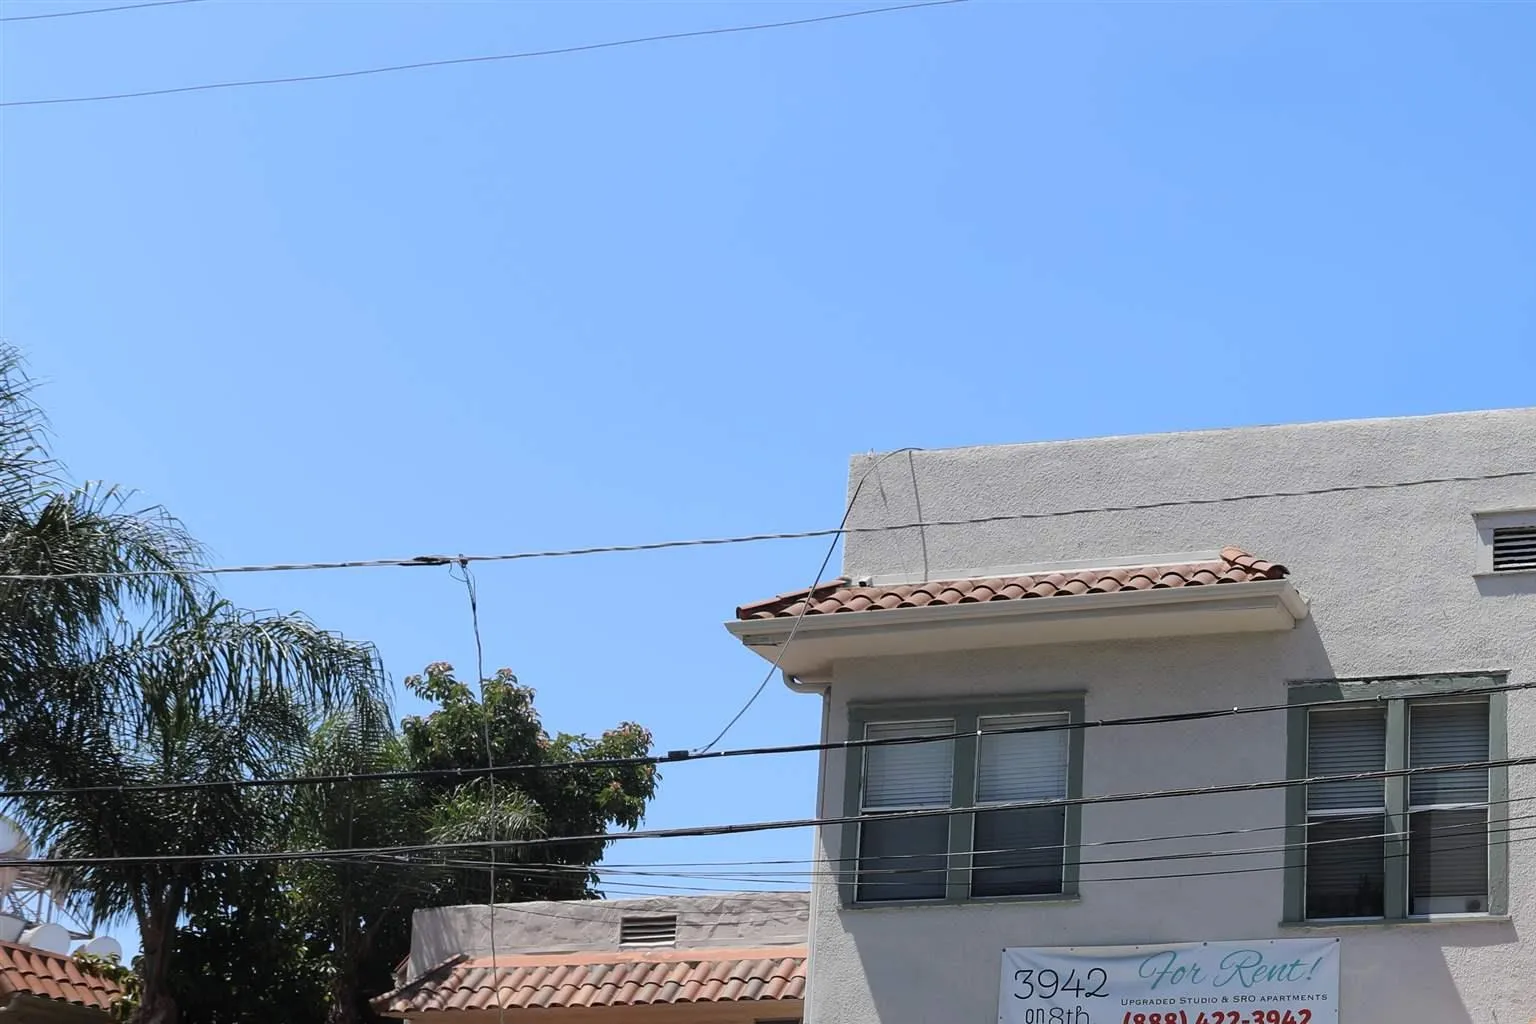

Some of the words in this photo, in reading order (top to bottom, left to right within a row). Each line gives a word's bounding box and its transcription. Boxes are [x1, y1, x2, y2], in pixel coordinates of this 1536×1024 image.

[1014, 968, 1110, 1000] 3942
[1139, 950, 1208, 990] For
[1213, 950, 1323, 988] Rent!
[1221, 996, 1230, 1004] &
[1233, 994, 1257, 1004] SRO
[1260, 993, 1329, 1003] APARTMENTS
